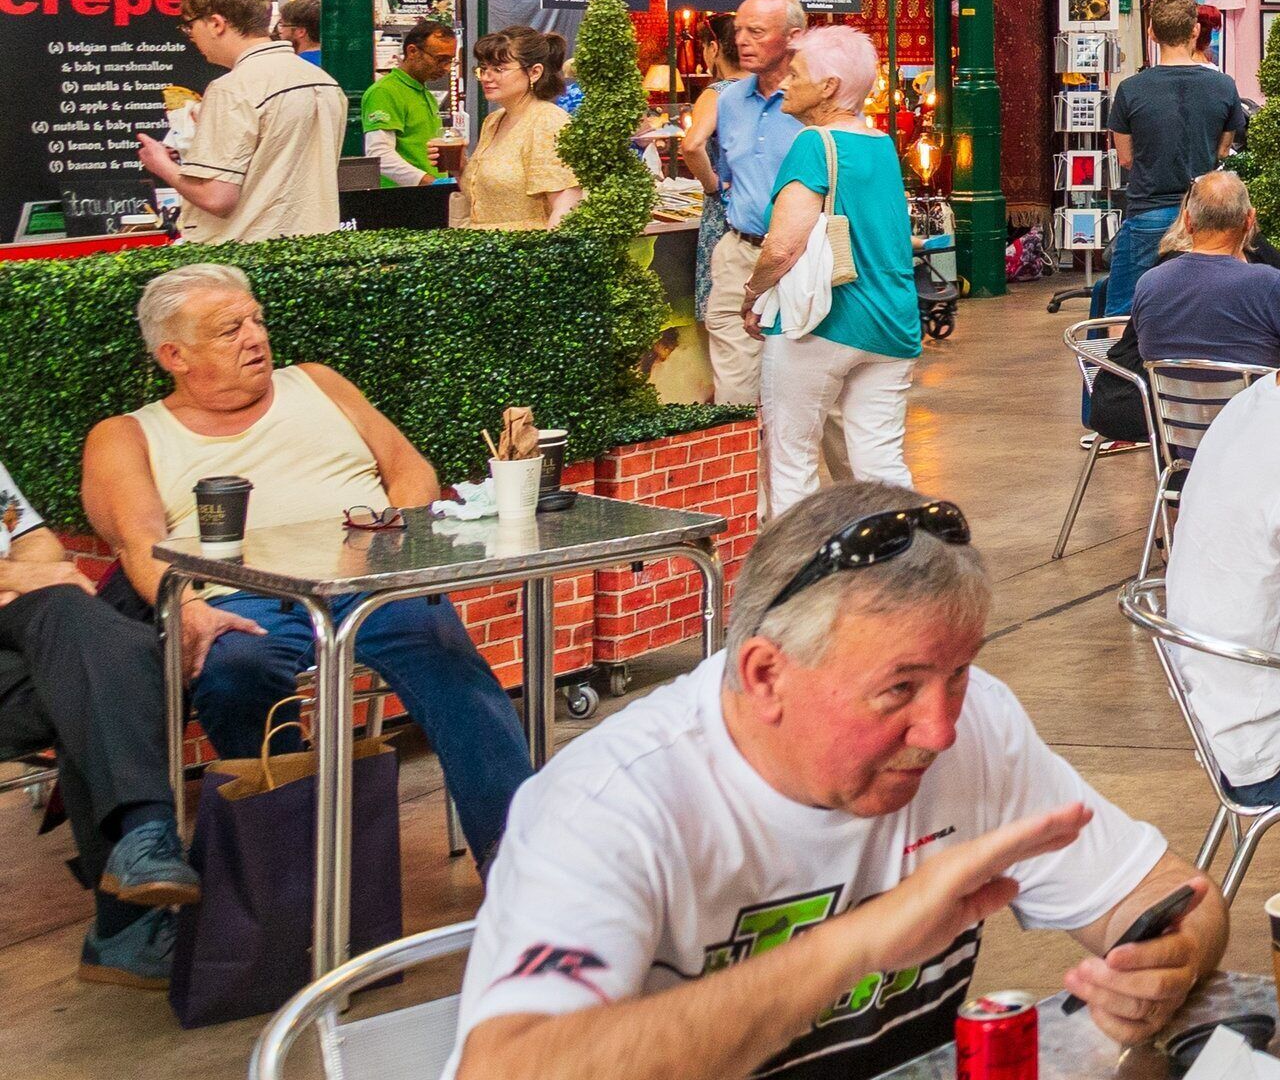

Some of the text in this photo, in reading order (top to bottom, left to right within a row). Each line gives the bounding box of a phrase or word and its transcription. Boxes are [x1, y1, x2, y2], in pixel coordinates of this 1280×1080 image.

[48, 41, 186, 55] (a) belgian milk chocolate
[61, 61, 173, 74] & baby marshmallow
[62, 81, 79, 93] (b)
[83, 81, 120, 91] nutella
[123, 81, 134, 91] &
[60, 101, 122, 114] (c) apple &
[31, 120, 131, 133] (d) nutella & baby
[48, 139, 140, 153] (e) lemon, butter
[50, 160, 120, 173] (f) banana &
